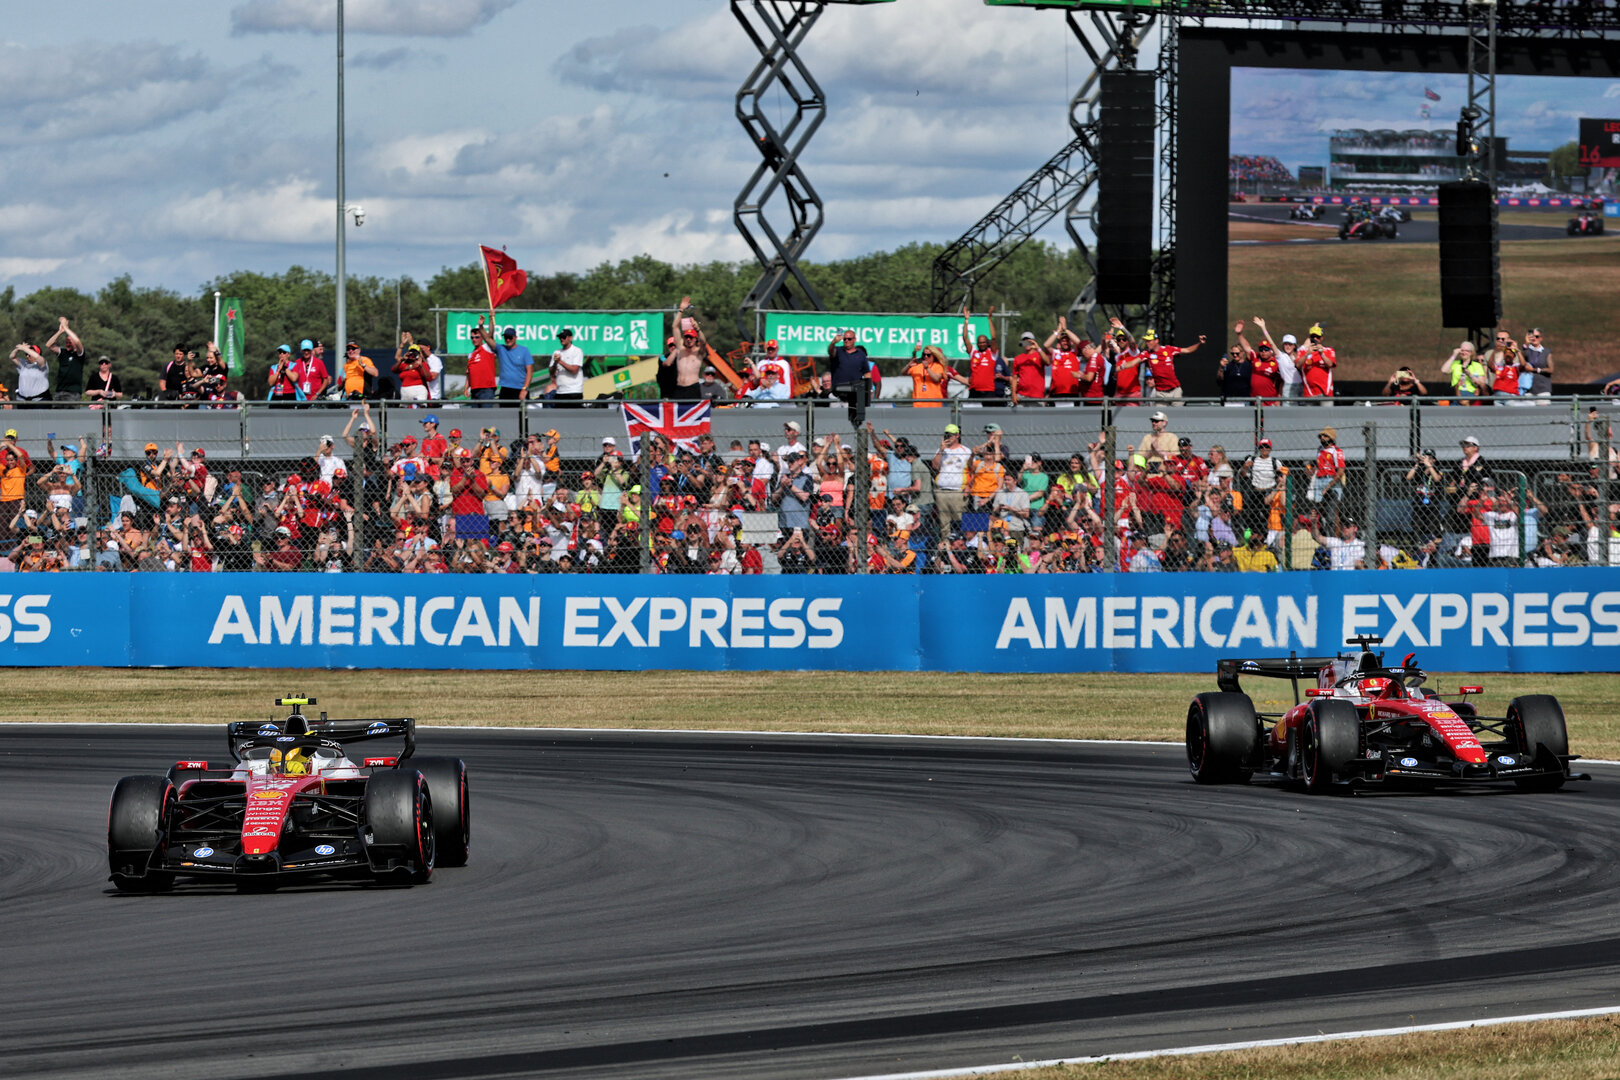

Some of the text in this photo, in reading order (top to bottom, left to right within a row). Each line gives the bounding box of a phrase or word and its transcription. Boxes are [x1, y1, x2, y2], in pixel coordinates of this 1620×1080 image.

[1580, 144, 1600, 162] 16
[227, 324, 235, 369] Heineken
[456, 324, 559, 341] ERENCY
[603, 325, 624, 342] B2
[888, 327, 926, 344] EXIT
[930, 328, 948, 344] B1
[207, 595, 844, 648] AMERICAN EXPRESS
[995, 592, 1620, 648] AMERICAN EXPRESS
